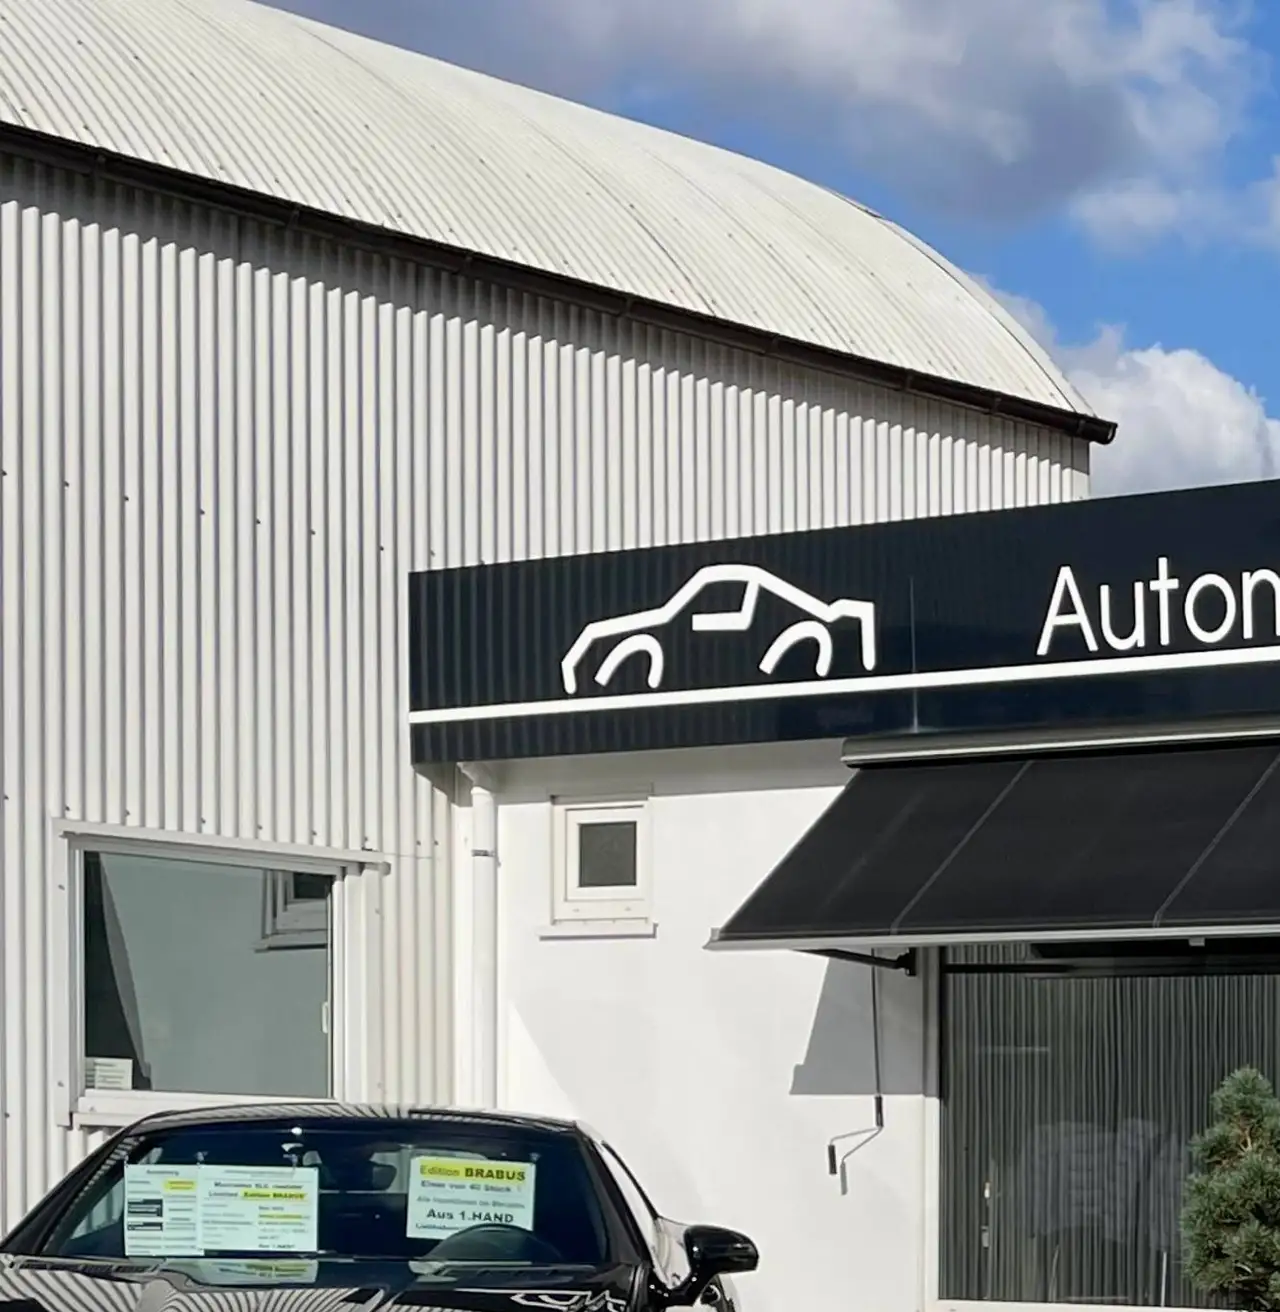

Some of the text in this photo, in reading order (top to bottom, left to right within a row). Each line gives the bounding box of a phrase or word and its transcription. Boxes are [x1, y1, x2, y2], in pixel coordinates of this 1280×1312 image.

[464, 1167, 526, 1181] BRABUS
[426, 1208, 514, 1223] Aus 1.HAND
